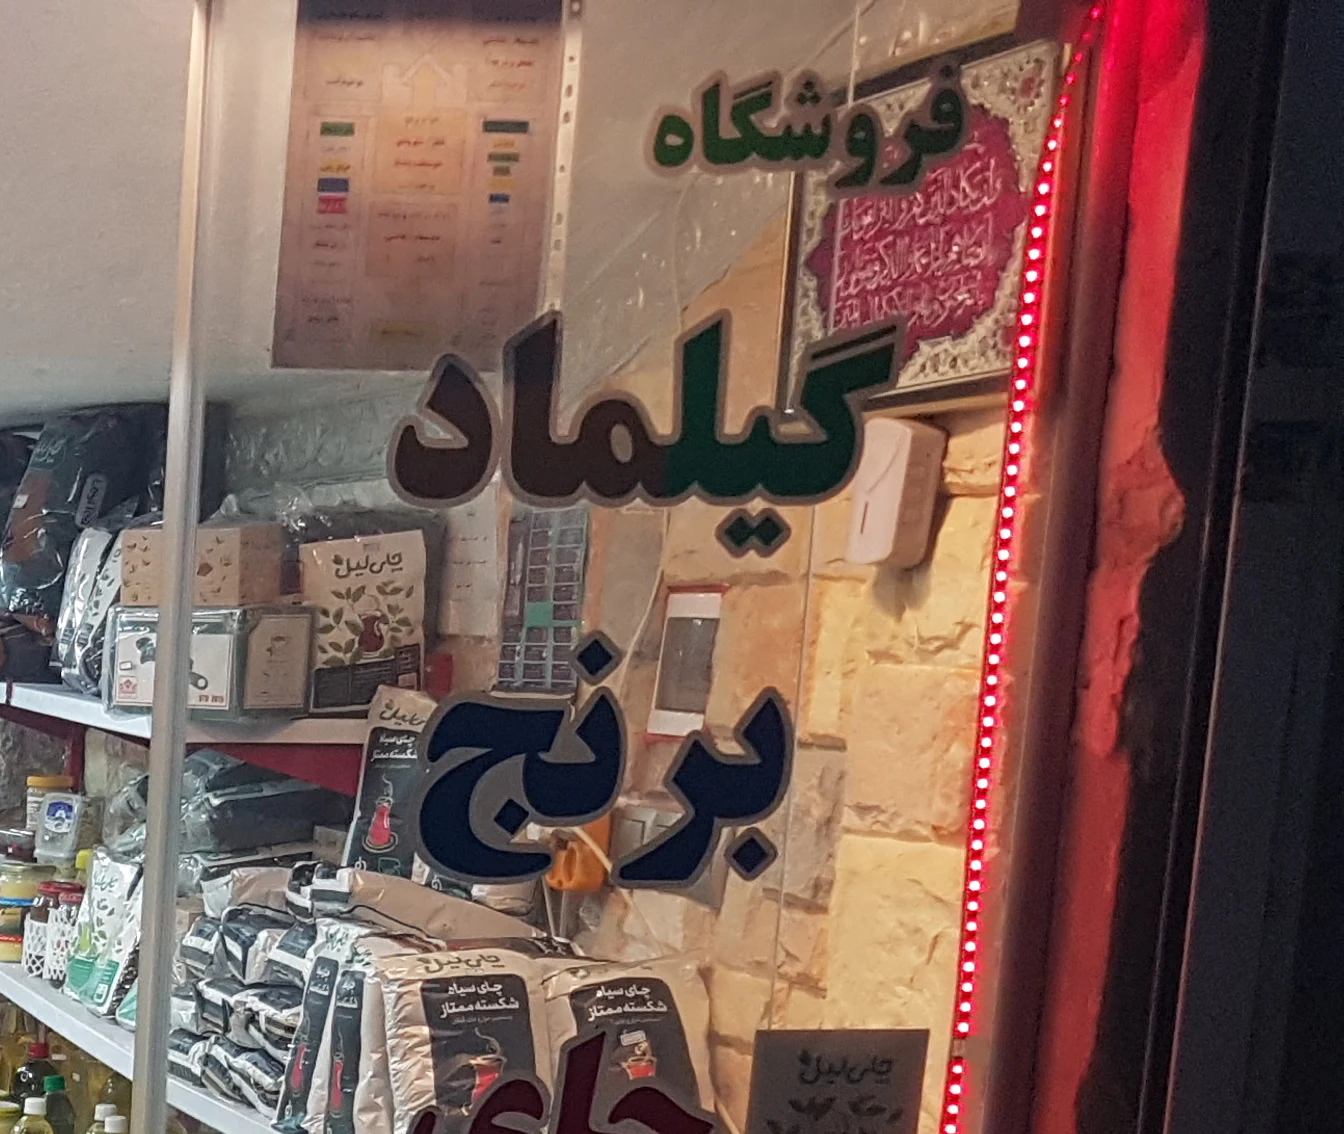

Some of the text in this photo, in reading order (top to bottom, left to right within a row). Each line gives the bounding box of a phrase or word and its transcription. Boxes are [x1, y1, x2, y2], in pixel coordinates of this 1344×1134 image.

[651, 64, 967, 189] فروشگاه
[394, 316, 899, 553] گیلماد
[418, 636, 790, 882] برنج
[447, 980, 503, 997] چای سیاه
[595, 984, 651, 1000] چای سیاه
[439, 997, 520, 1019] شکسته ممتاز
[587, 1000, 669, 1022] شکسته ممتاز
